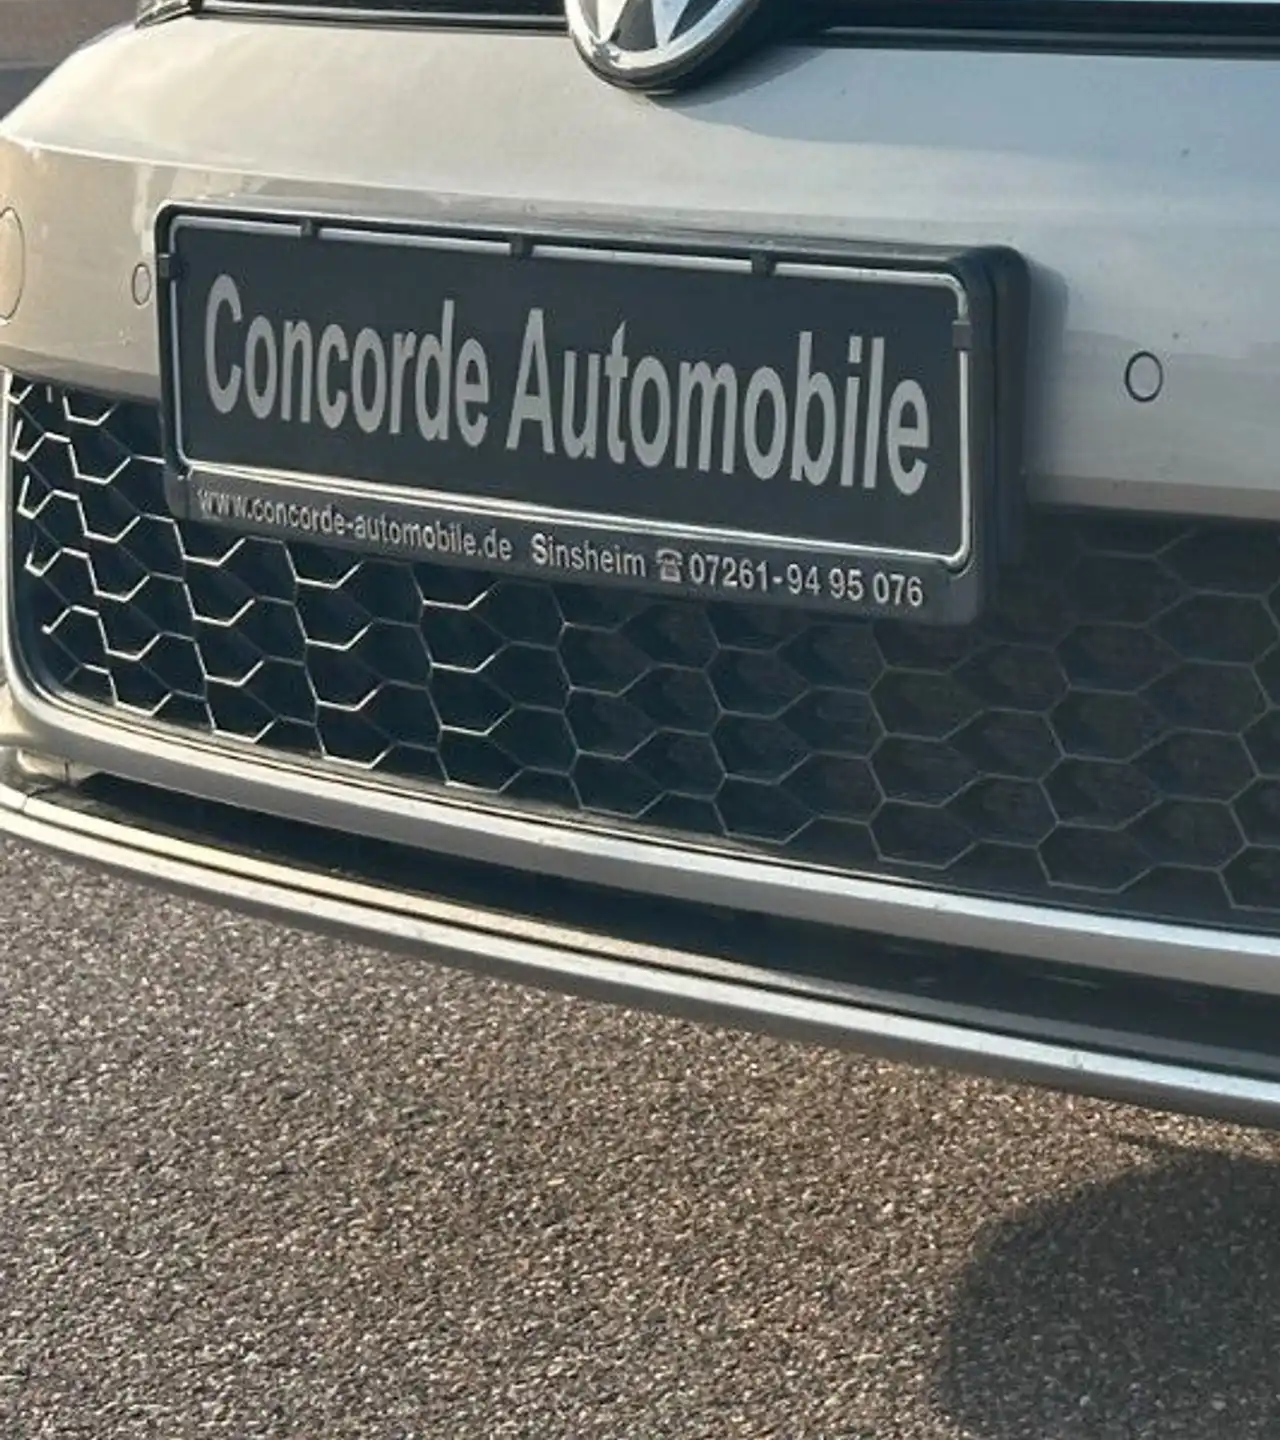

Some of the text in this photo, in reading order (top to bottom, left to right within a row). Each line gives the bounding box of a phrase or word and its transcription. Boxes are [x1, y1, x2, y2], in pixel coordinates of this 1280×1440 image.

[205, 274, 930, 496] Concorde Automobile
[197, 489, 512, 561] www.concorde-automobile.de
[530, 532, 647, 578] Sinsheim
[828, 568, 864, 602] 95
[872, 572, 924, 607] 076
